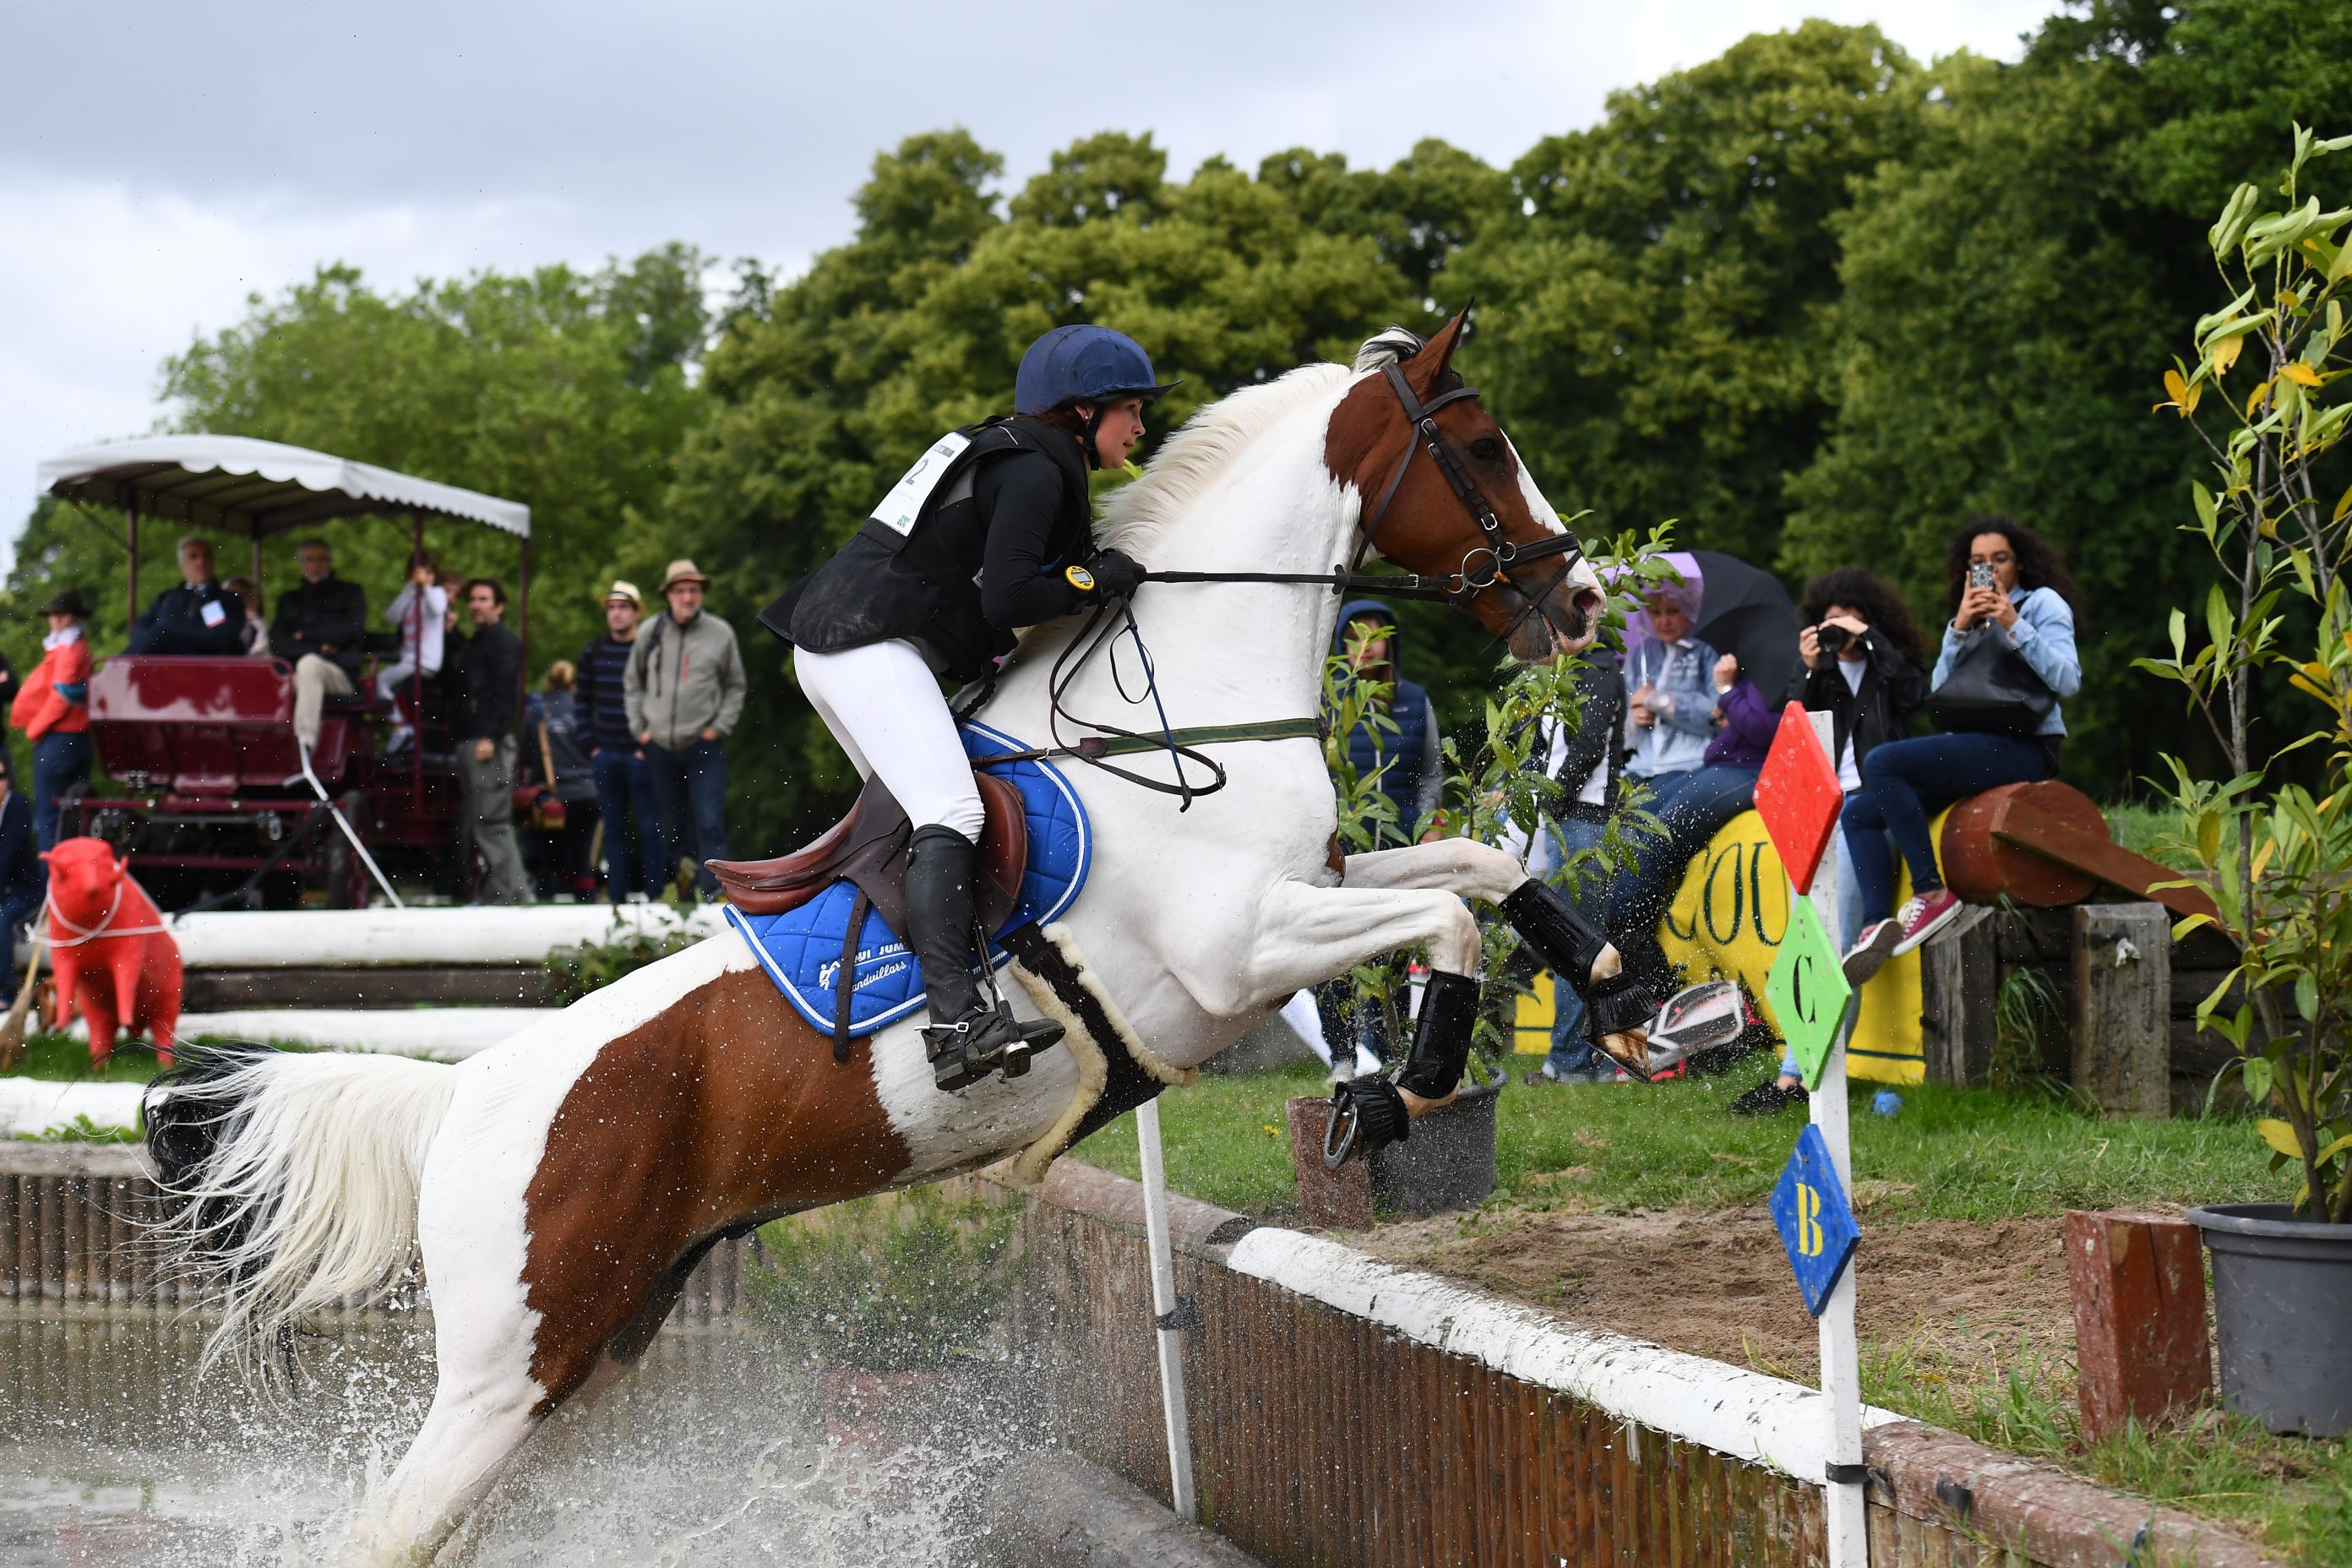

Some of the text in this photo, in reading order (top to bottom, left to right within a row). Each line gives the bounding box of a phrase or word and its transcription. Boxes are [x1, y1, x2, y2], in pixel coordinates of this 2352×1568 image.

[904, 459, 928, 486] 2
[879, 942, 907, 956] JUM
[851, 960, 907, 994] andvillars
[1793, 954, 1816, 1024] C
[1795, 1183, 1823, 1257] B
